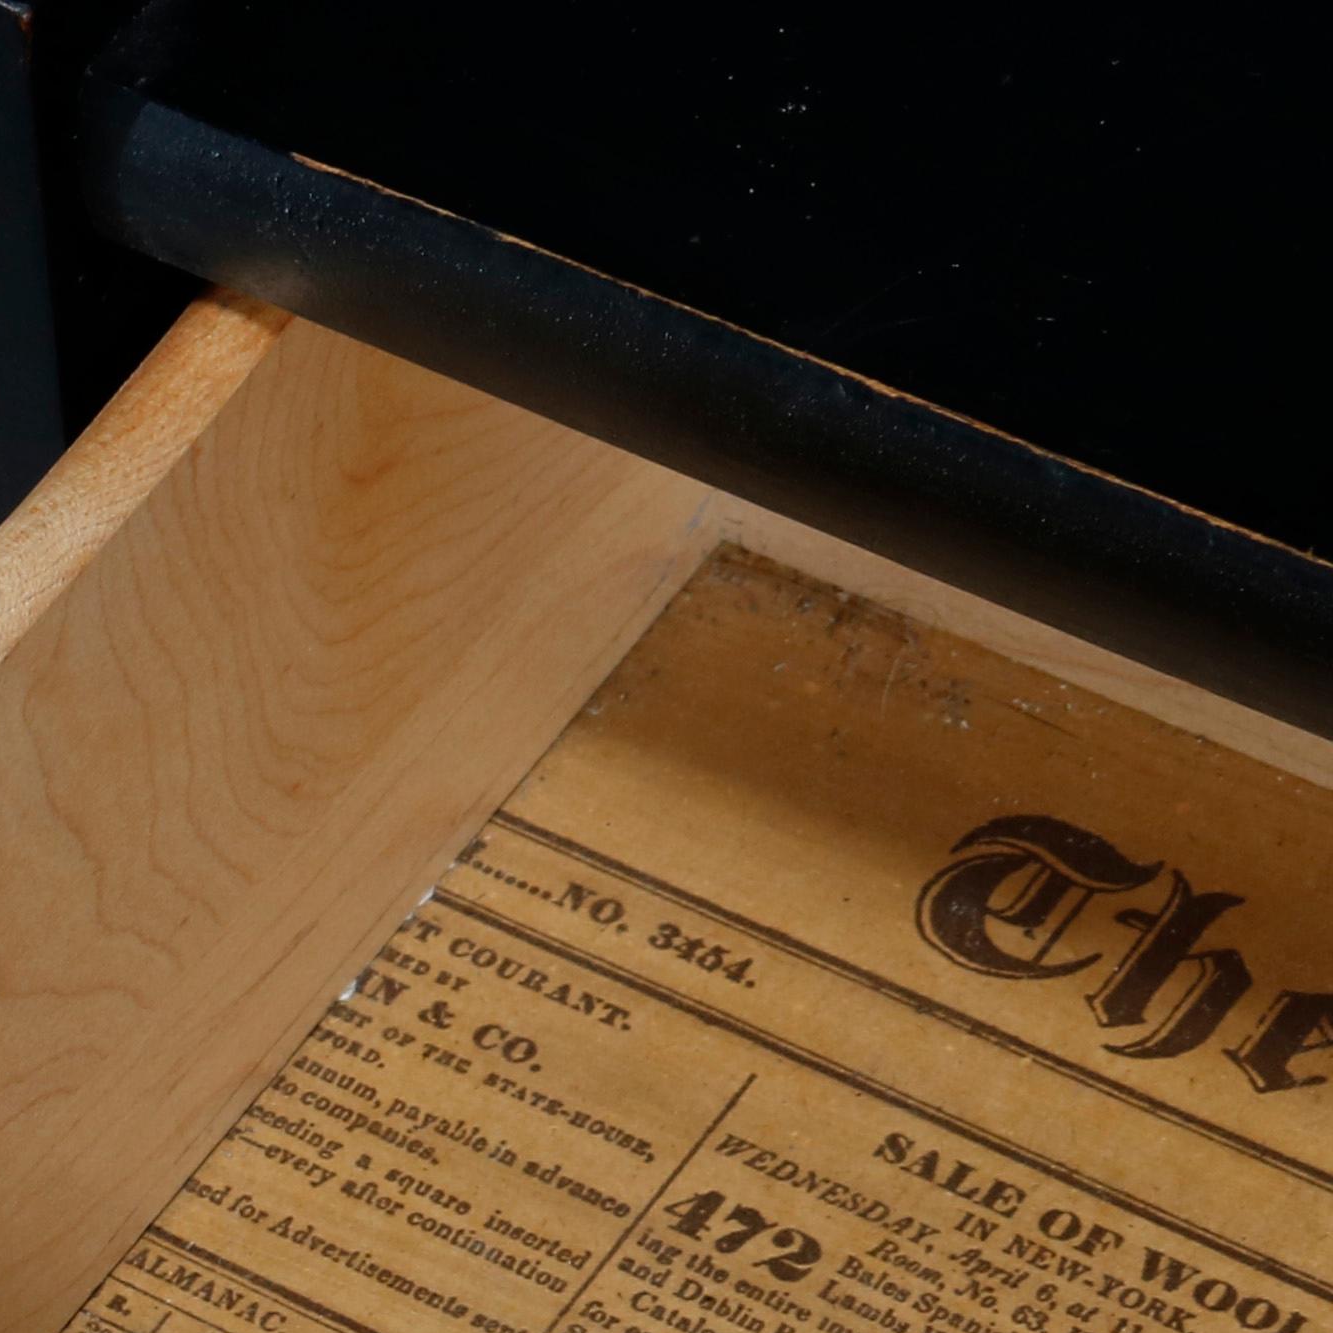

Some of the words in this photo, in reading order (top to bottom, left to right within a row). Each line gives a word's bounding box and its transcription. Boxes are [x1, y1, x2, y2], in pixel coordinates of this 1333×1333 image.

[447, 936, 632, 1032] COURANT.
[646, 921, 756, 989] 3454.
[380, 1025, 417, 1048] OF
[662, 1189, 823, 1283] 472
[871, 1131, 1027, 1219] SALE
[1037, 1207, 1125, 1257] OF
